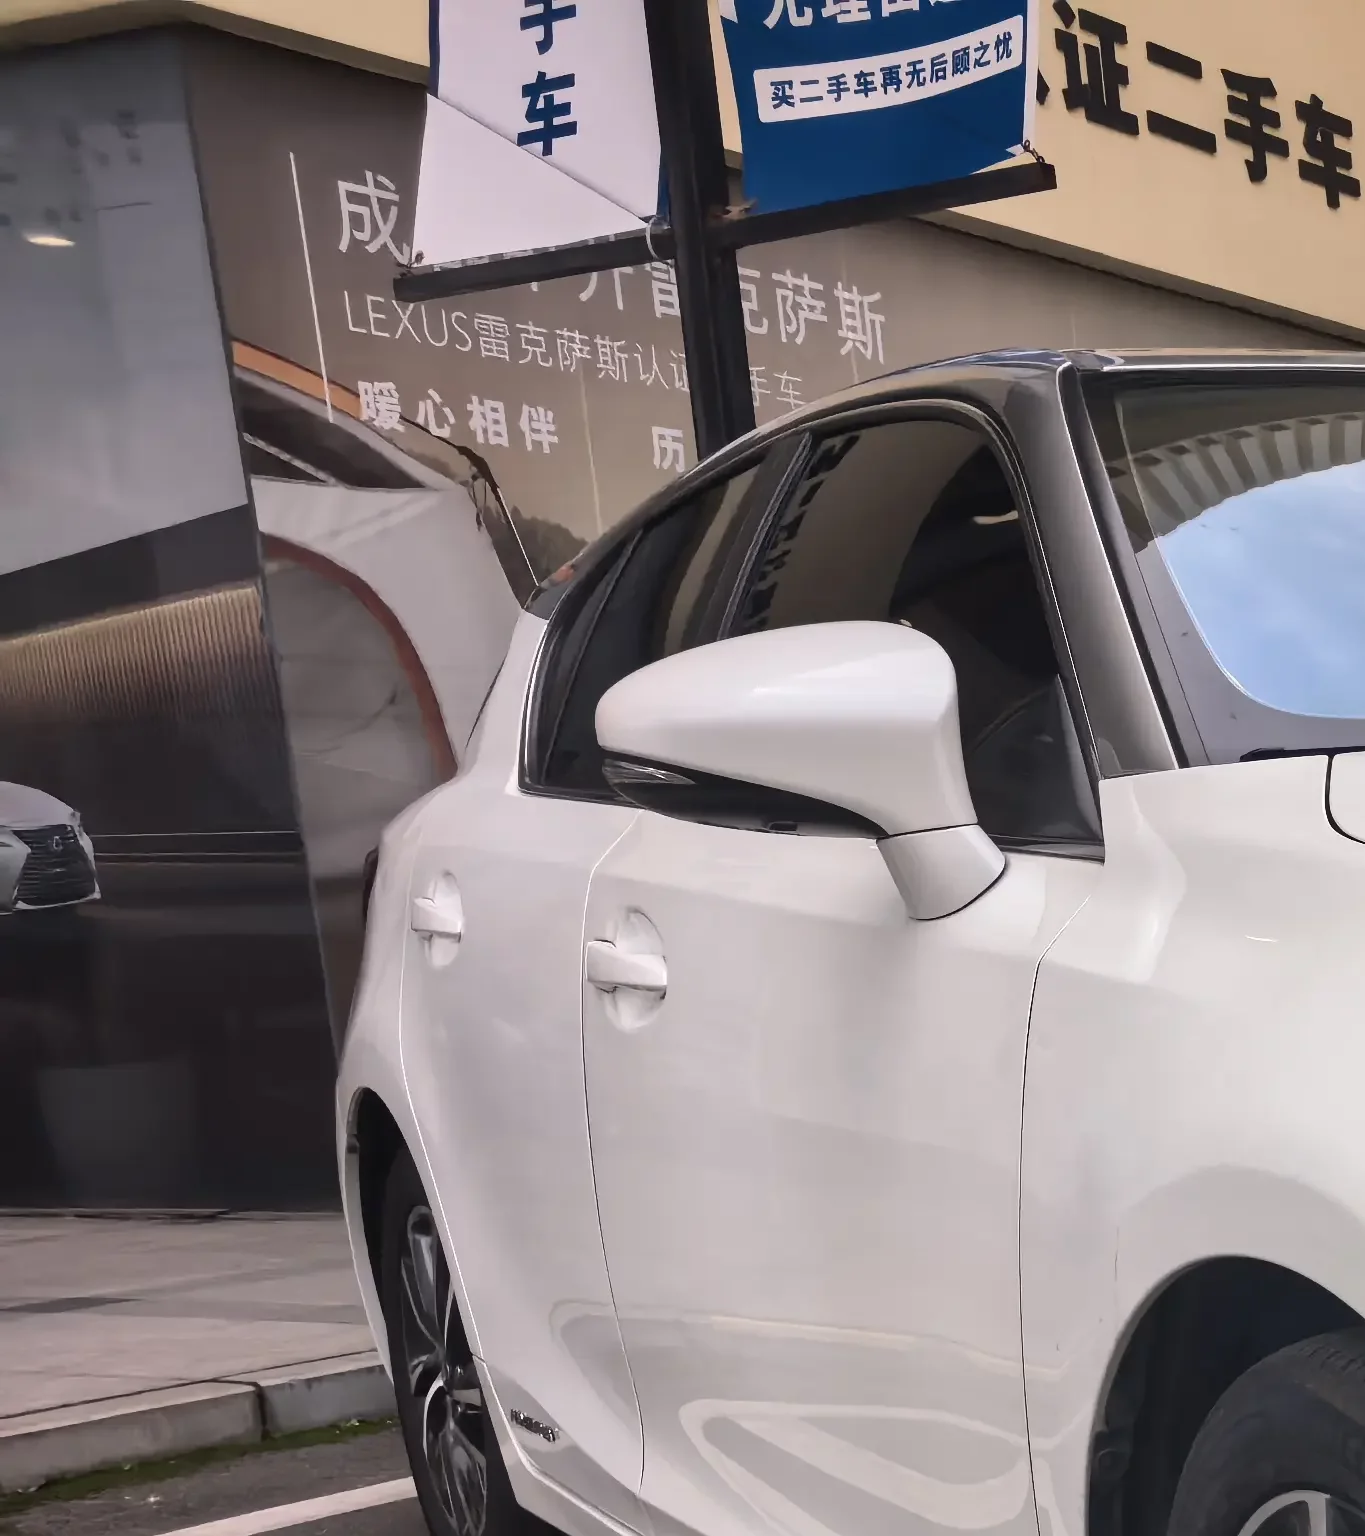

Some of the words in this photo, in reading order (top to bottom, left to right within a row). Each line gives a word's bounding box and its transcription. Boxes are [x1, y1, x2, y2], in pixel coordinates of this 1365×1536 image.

[769, 31, 1013, 110] 买二手车再无后顾之忧
[1037, 0, 1361, 209] 证二手车
[357, 380, 559, 454] 暖心相伴
